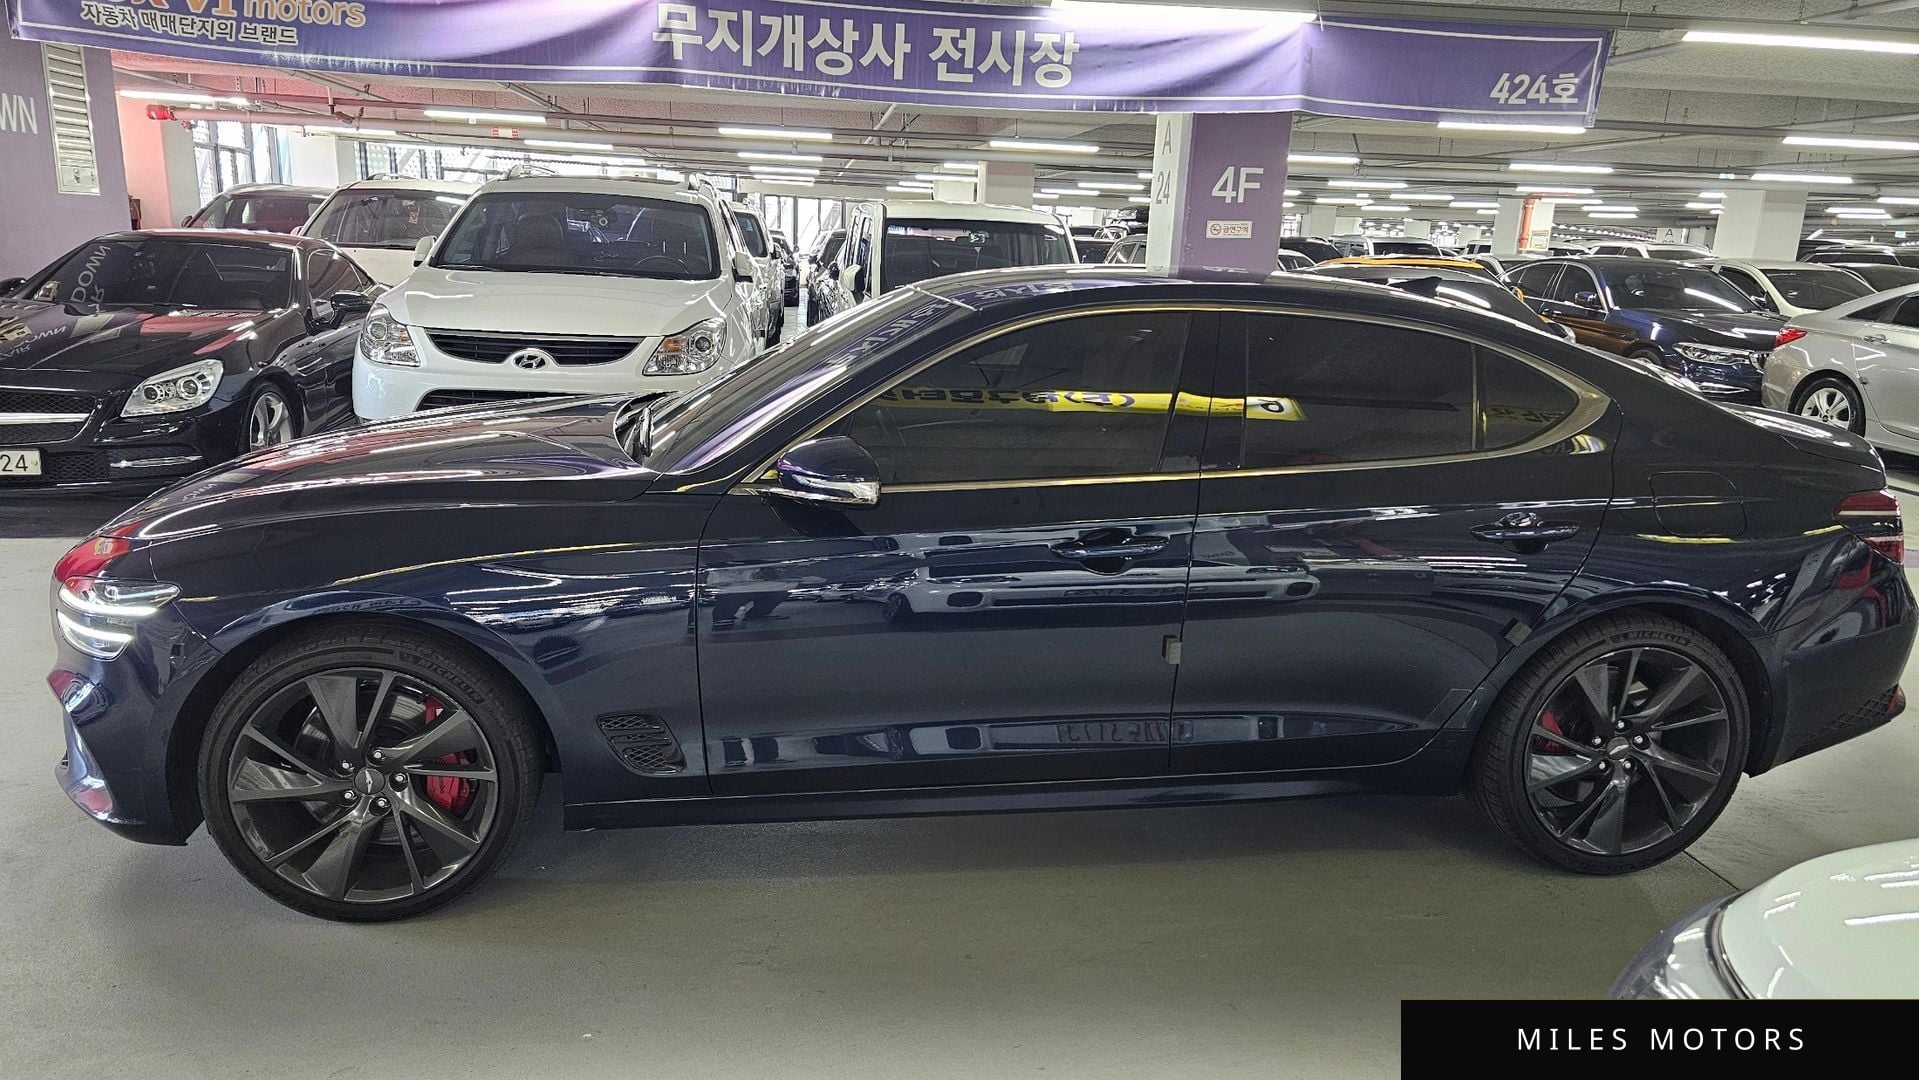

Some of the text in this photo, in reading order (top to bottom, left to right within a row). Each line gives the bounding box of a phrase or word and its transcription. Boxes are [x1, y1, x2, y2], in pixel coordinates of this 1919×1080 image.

[82, 3, 138, 29] 자동차
[140, 10, 236, 40] 매매단지의
[240, 23, 298, 45] 브랜드
[244, 0, 366, 27] motors
[652, 3, 1080, 89] 무지개상사 전시장
[1489, 72, 1580, 105] 424호
[1161, 119, 1172, 155] A
[1155, 170, 1171, 205] 24
[1211, 166, 1265, 203] 4F
[0, 454, 28, 472] 24
